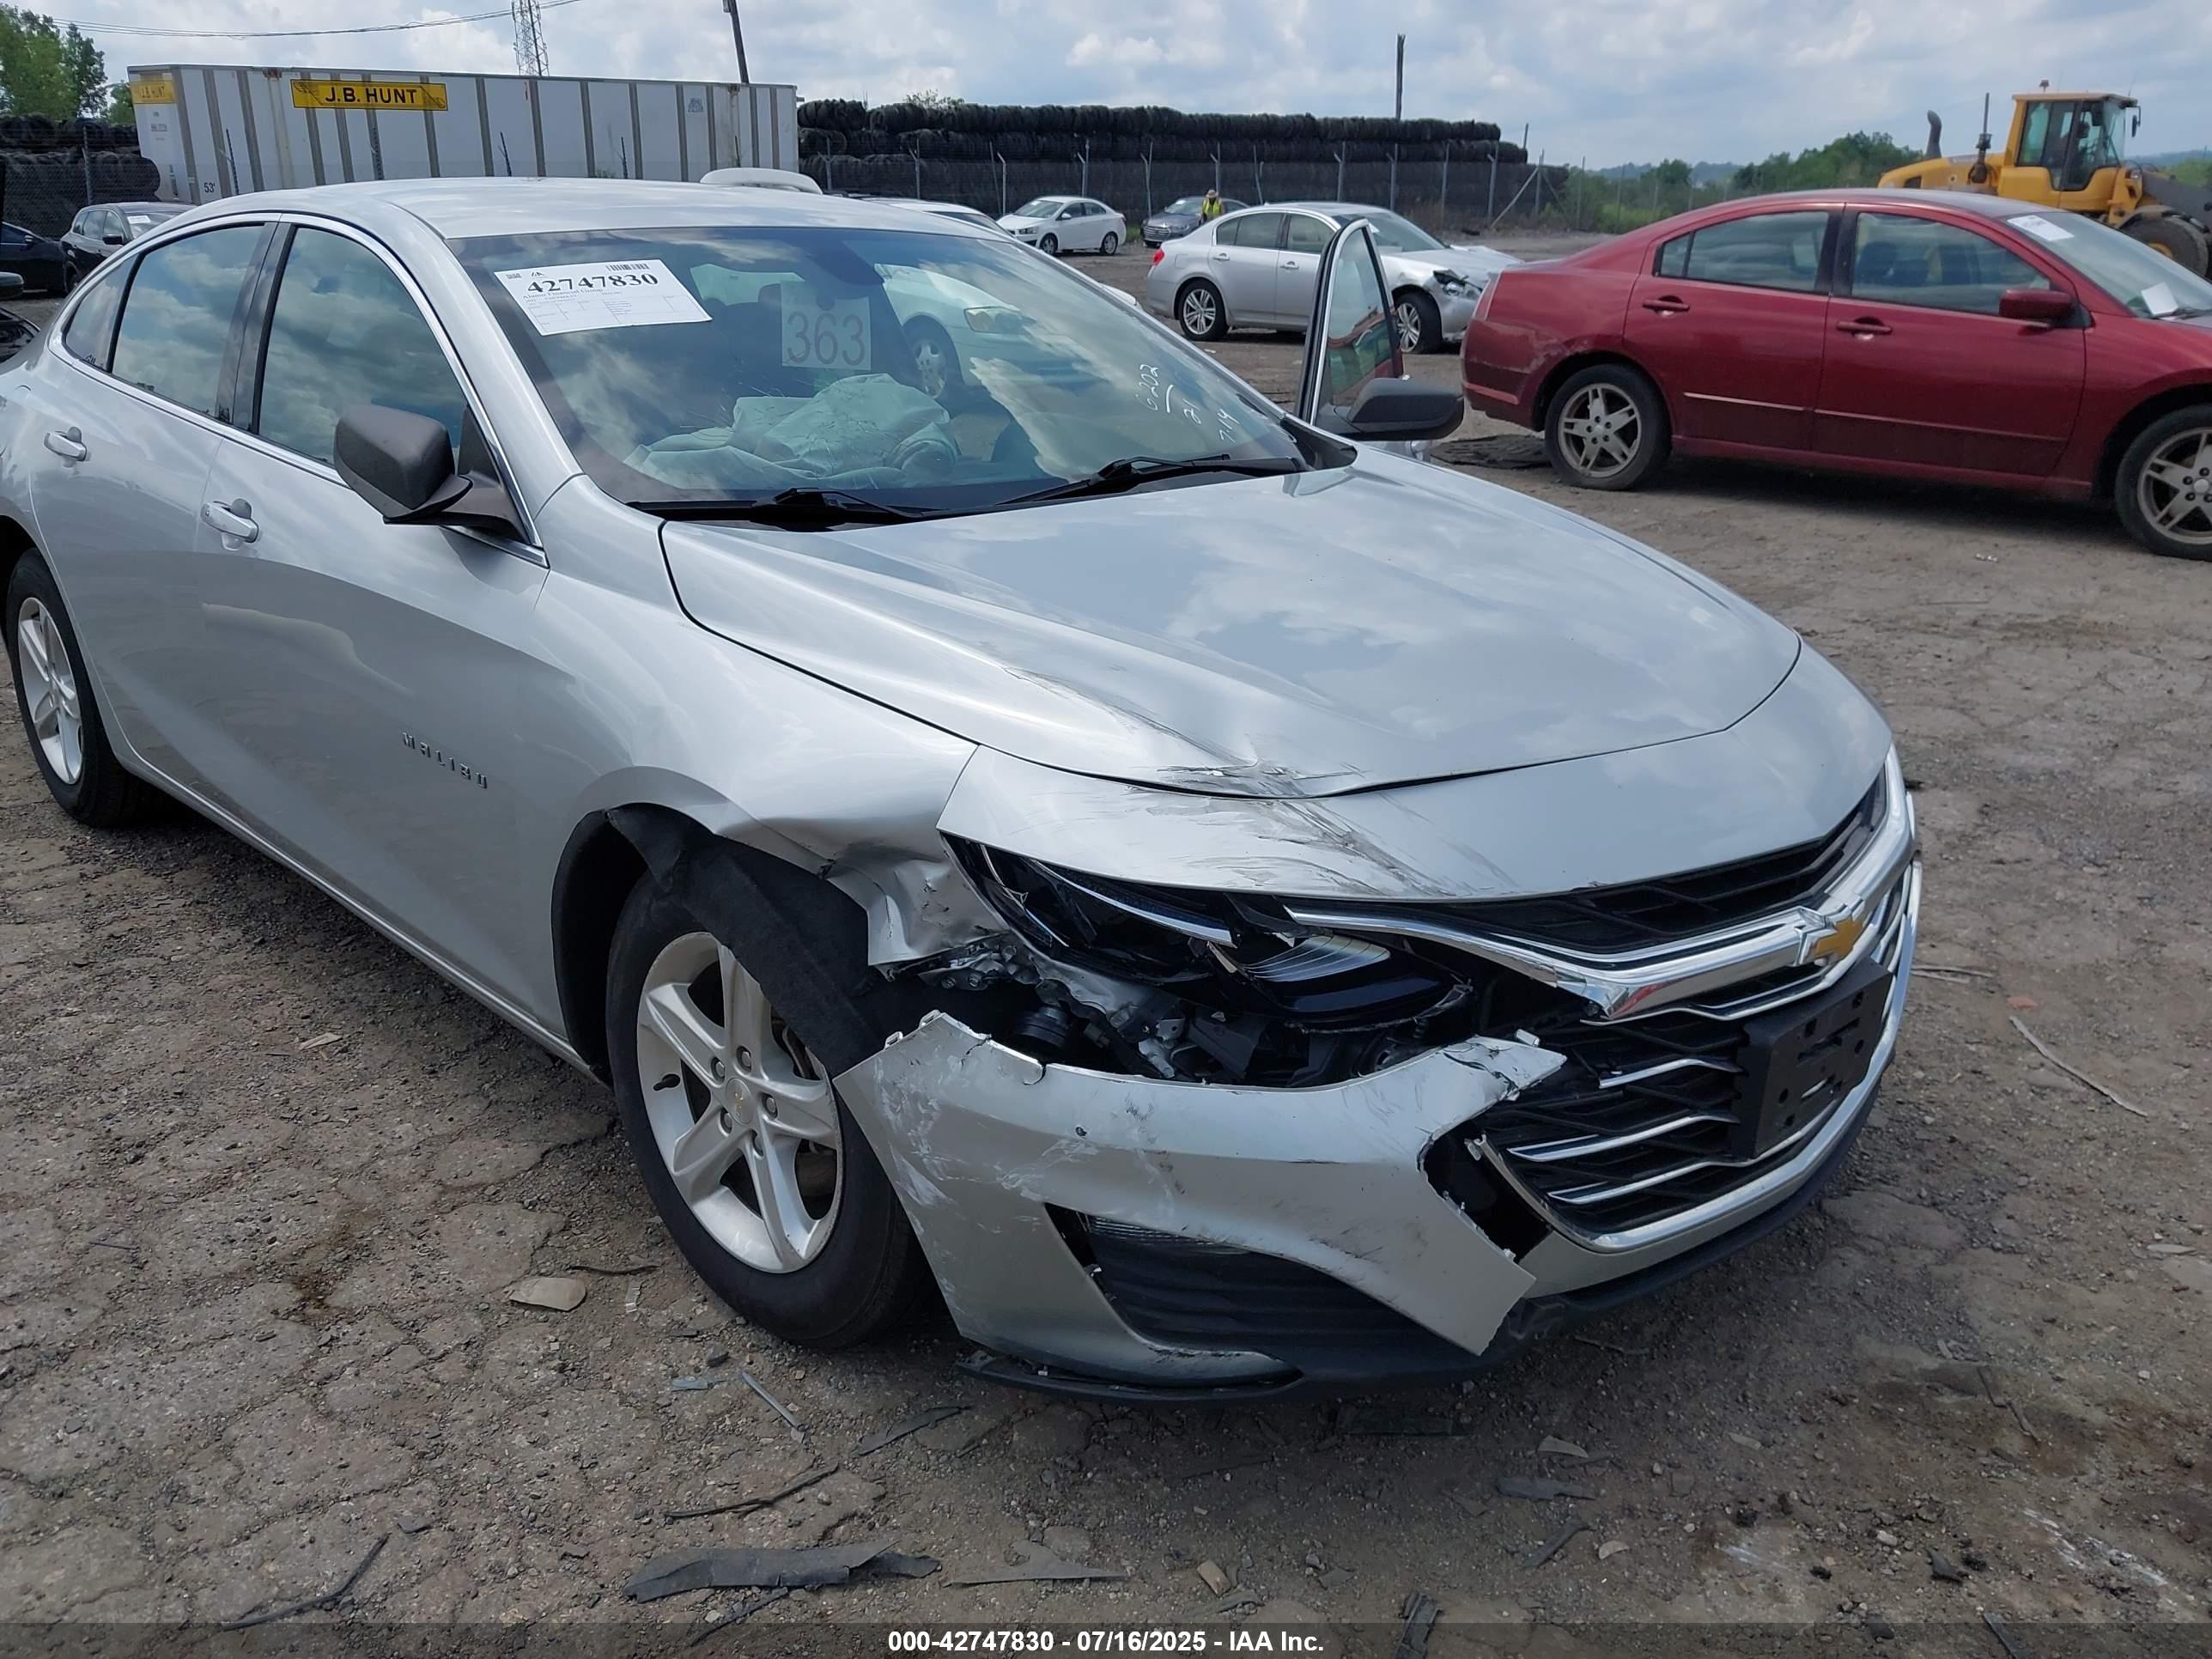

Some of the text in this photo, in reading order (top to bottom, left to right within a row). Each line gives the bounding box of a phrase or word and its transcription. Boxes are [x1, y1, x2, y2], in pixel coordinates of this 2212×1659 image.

[325, 87, 417, 104] J.B. HUNT
[528, 274, 658, 292] 42747830
[787, 311, 866, 366] 363
[402, 732, 488, 789] MALIBU
